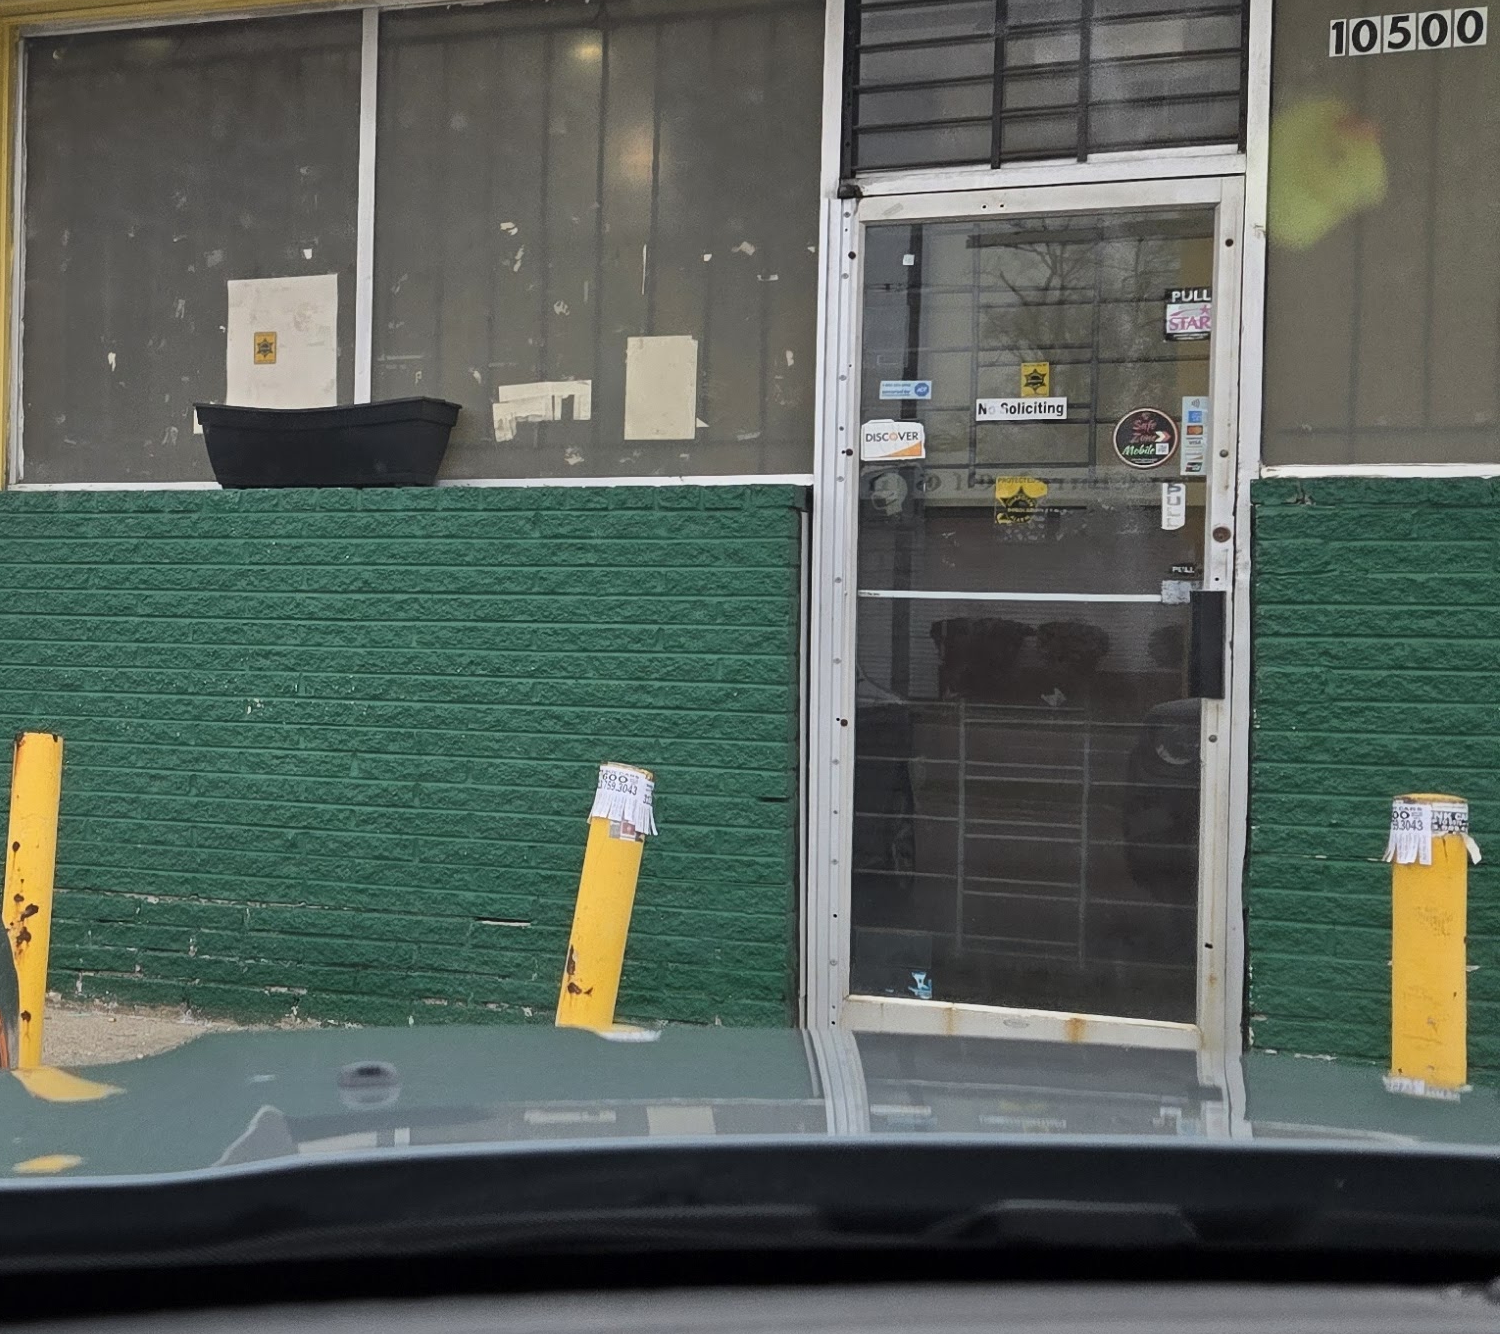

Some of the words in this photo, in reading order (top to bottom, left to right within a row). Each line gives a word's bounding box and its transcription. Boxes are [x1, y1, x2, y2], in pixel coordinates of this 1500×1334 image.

[1331, 9, 1484, 55] 10500
[1171, 289, 1211, 303] PULL
[1169, 316, 1210, 331] STAR
[978, 402, 996, 416] No
[1000, 401, 1065, 417] Soliciting
[865, 431, 919, 443] DISCOVER
[1122, 444, 1155, 455] Mobile
